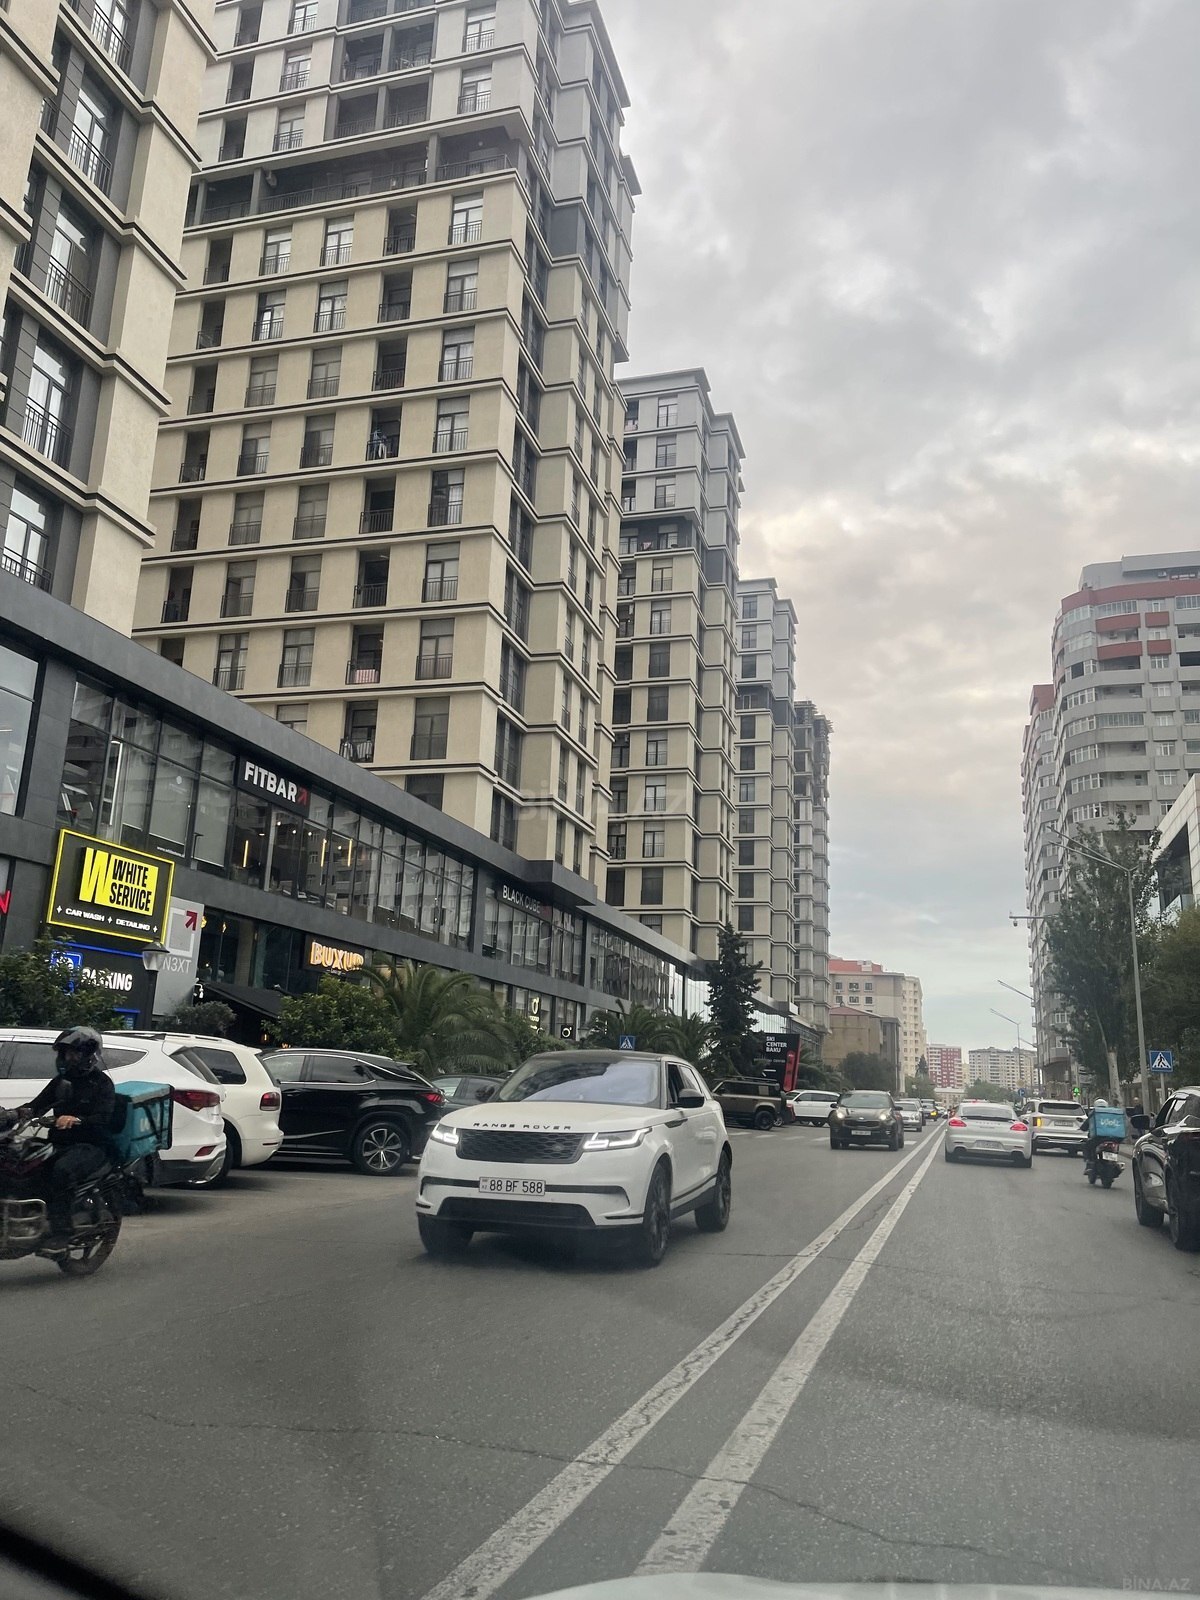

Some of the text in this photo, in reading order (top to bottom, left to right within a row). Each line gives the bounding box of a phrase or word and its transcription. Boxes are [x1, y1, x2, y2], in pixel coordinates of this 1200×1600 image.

[244, 761, 298, 803] FITBAR
[112, 858, 149, 888] WHITE
[109, 882, 152, 912] SERVICE
[502, 884, 541, 914] BLACK CUBE
[65, 907, 105, 922] CAR WASH
[115, 918, 151, 931] DETAILING
[162, 956, 192, 974] N3XT
[489, 1179, 503, 1192] 88
[505, 1180, 519, 1192] BF
[522, 1181, 543, 1194] 588
